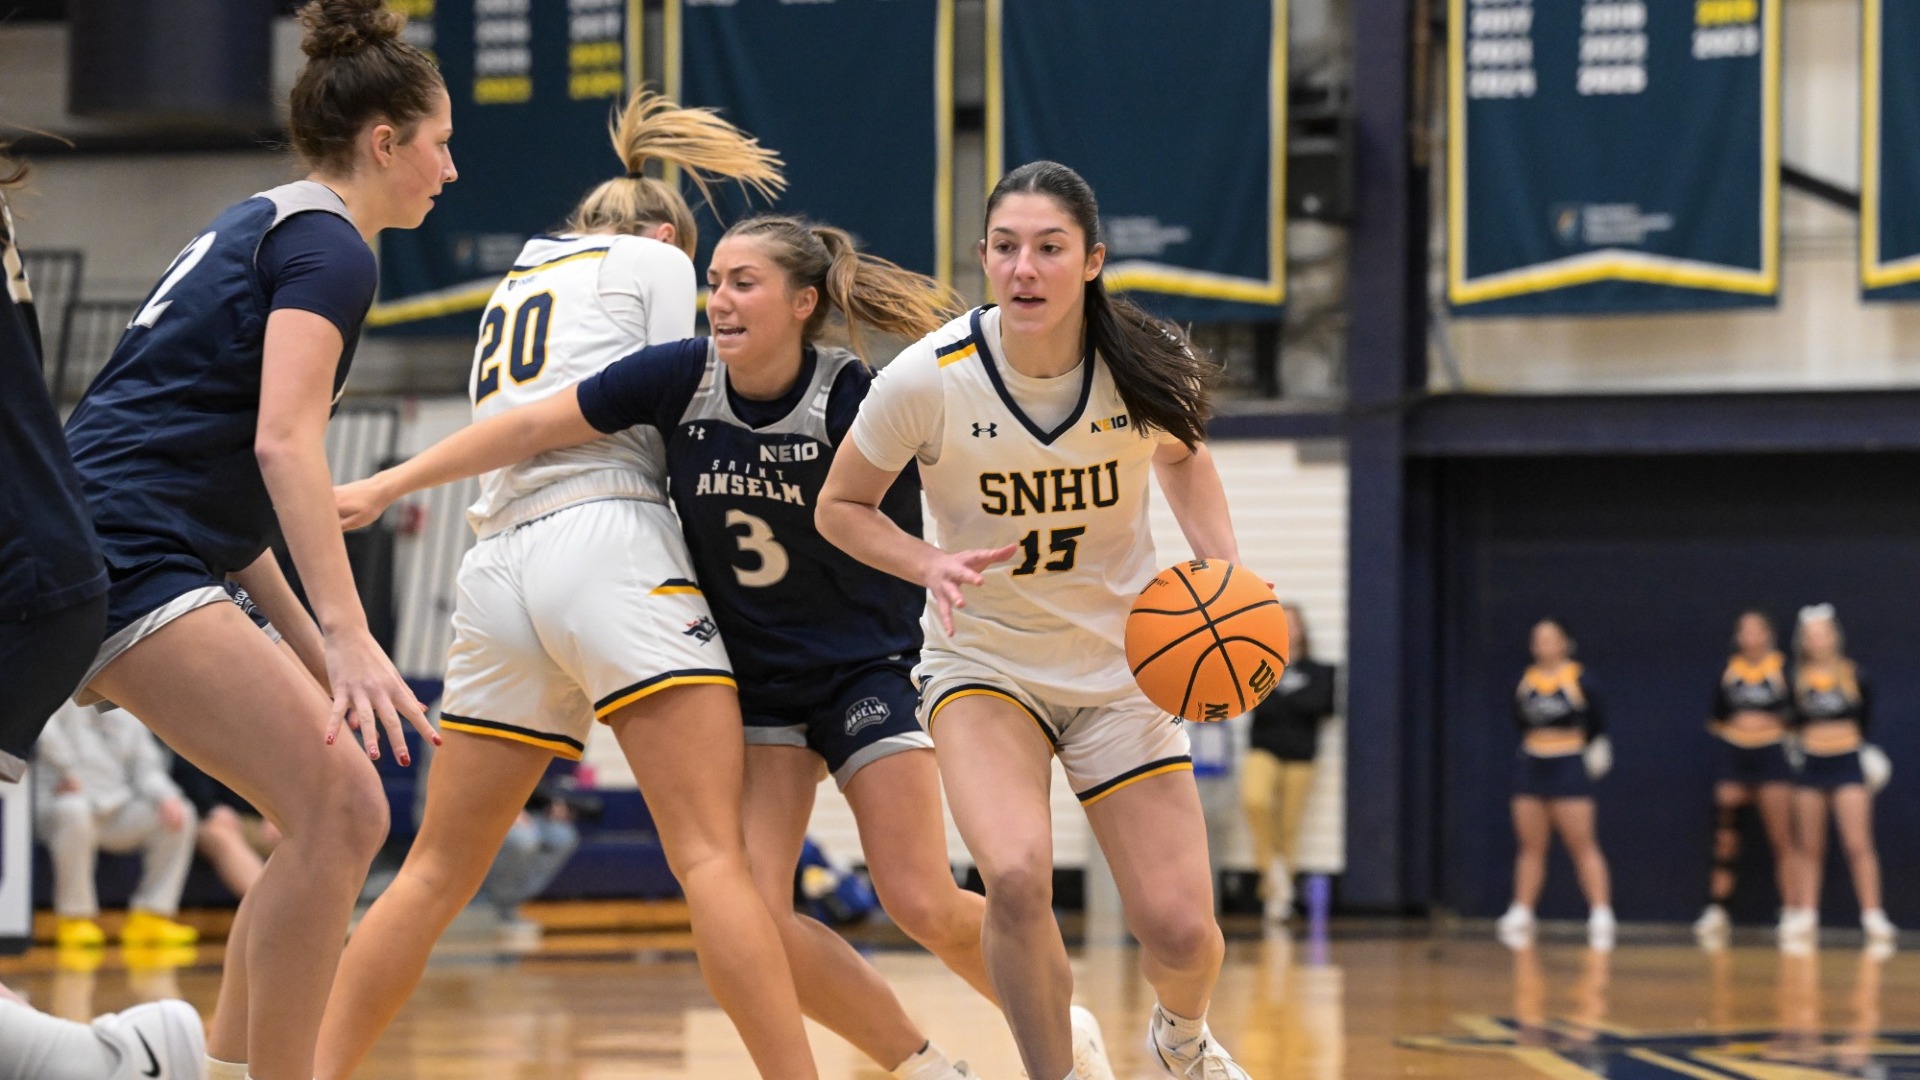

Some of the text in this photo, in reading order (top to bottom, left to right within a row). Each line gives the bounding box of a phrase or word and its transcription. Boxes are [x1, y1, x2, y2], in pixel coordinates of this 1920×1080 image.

[126, 231, 216, 329] 2
[475, 289, 557, 408] 20
[712, 459, 784, 481] SAINT
[760, 442, 819, 462] NE10
[696, 473, 806, 506] ANSELM
[979, 459, 1120, 517] SNHU
[725, 509, 790, 588] 3
[1012, 524, 1087, 576] 15
